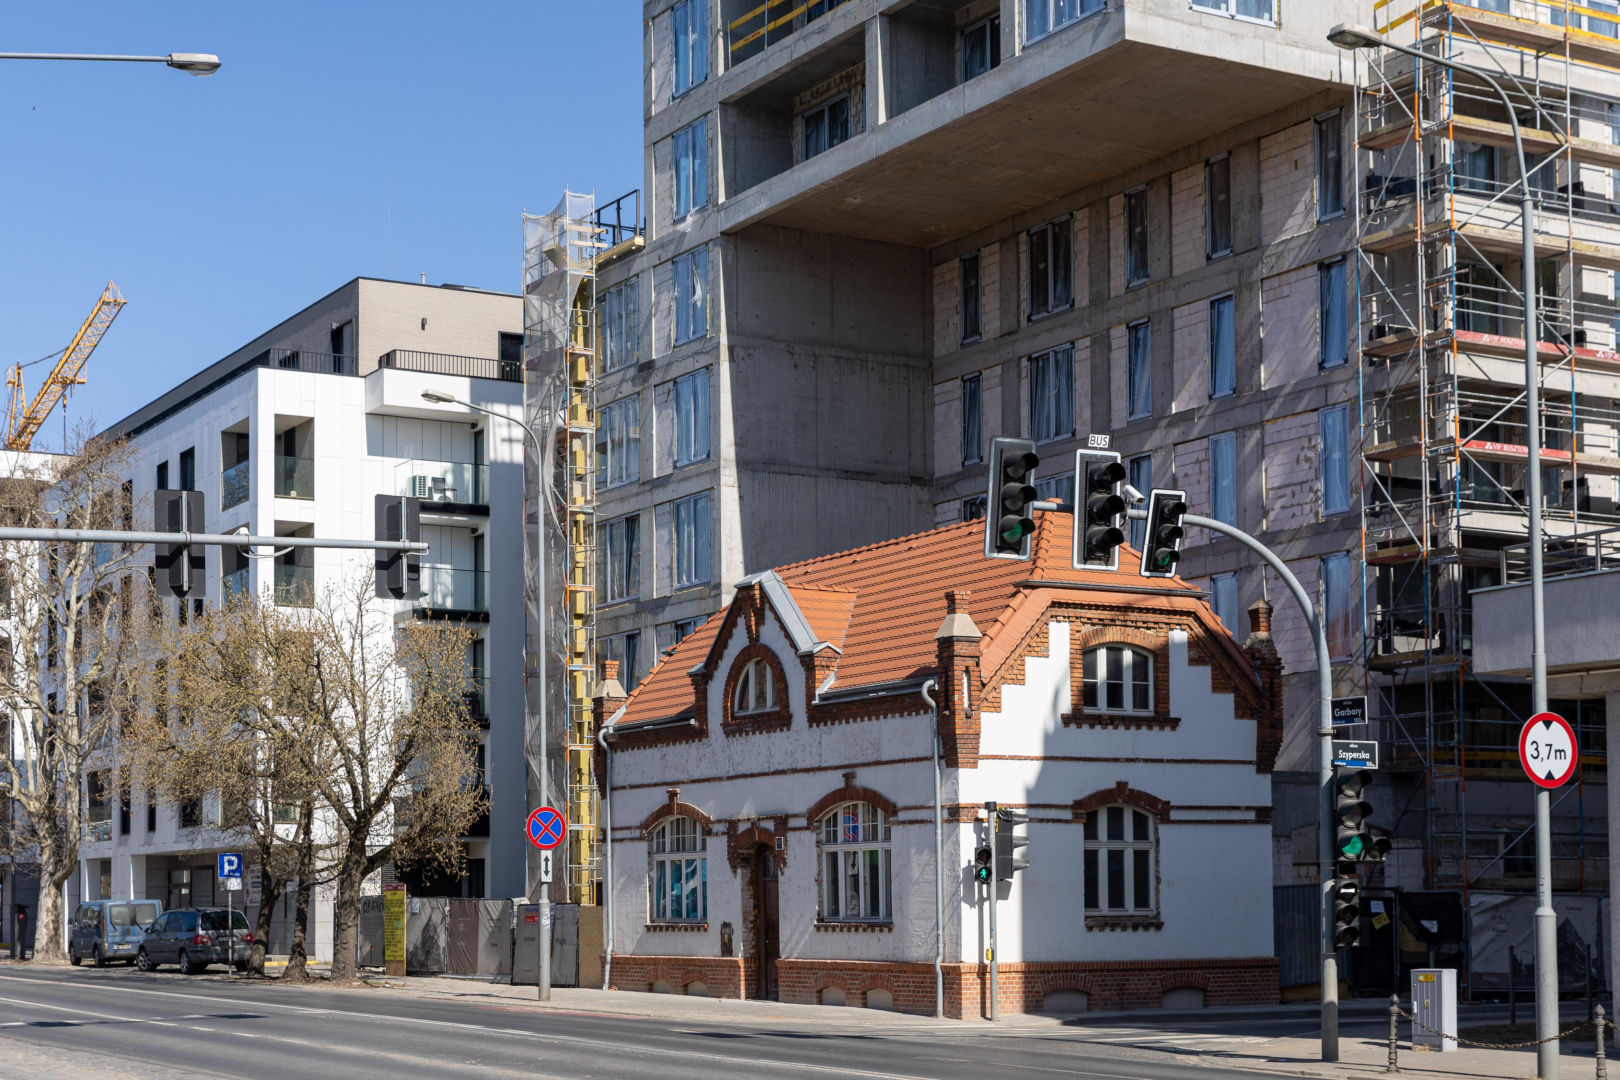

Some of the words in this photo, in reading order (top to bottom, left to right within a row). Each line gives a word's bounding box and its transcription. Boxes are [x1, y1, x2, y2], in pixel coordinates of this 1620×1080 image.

[1090, 435, 1108, 447] BUS
[1334, 707, 1362, 717] Garbary
[1338, 749, 1371, 761] Szyperska
[1530, 740, 1567, 763] 3,7m
[223, 855, 238, 876] P
